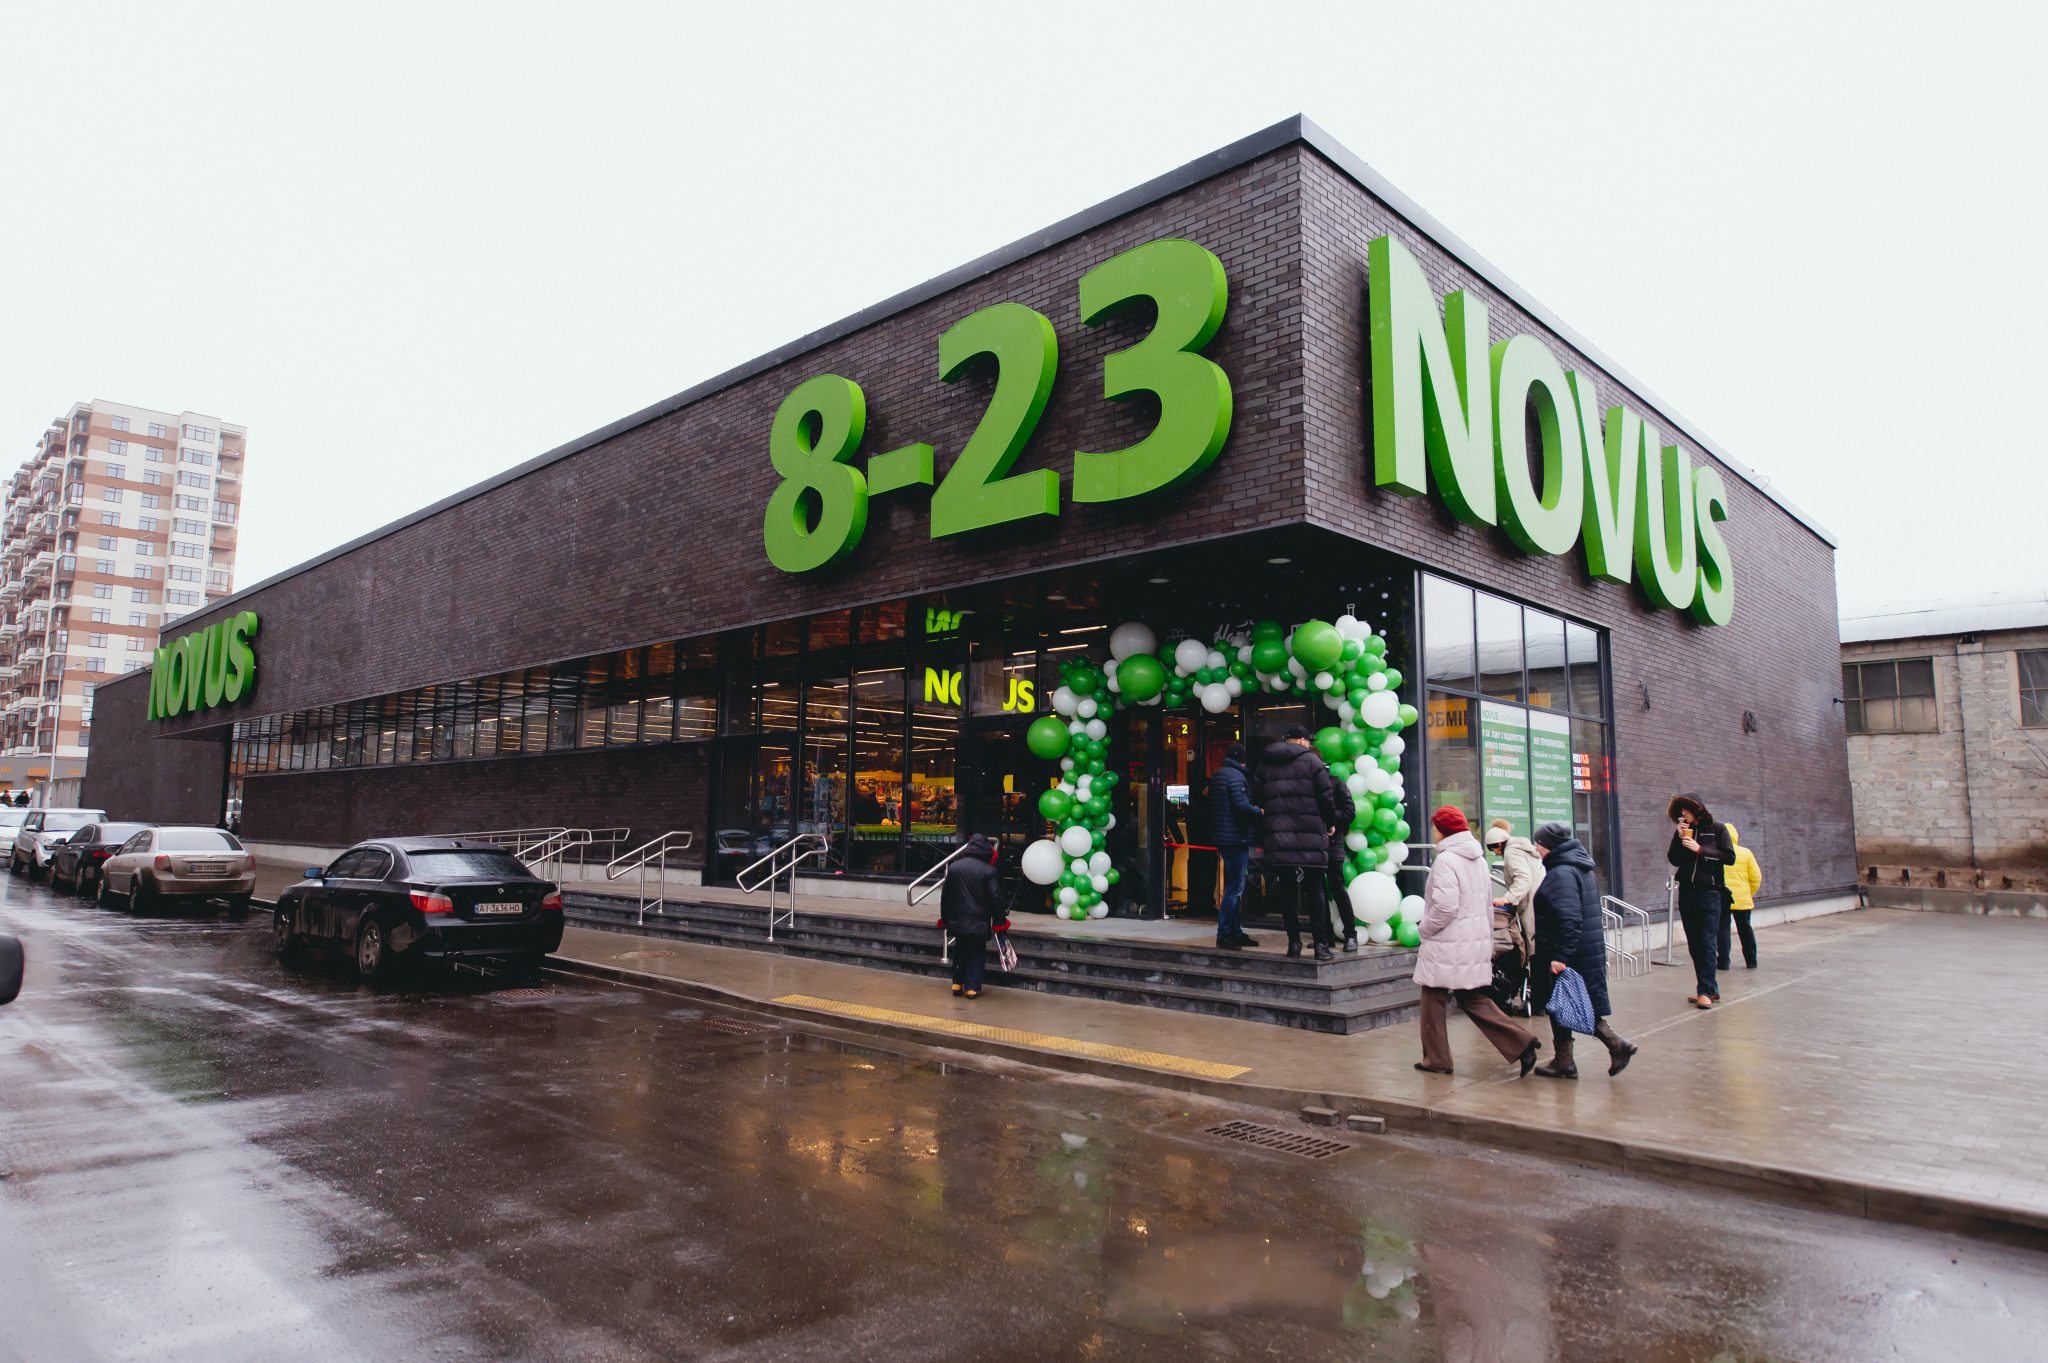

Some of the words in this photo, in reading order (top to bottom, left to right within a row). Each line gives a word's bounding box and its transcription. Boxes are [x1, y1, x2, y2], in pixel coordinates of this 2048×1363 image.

[764, 238, 1233, 573] 8-23
[1368, 234, 1734, 626] NOVUS
[147, 611, 257, 720] NOVUS
[1481, 708, 1499, 721] NOVUS
[1181, 724, 1188, 735] 2
[1235, 730, 1240, 741] 1
[491, 904, 509, 913] 3636
